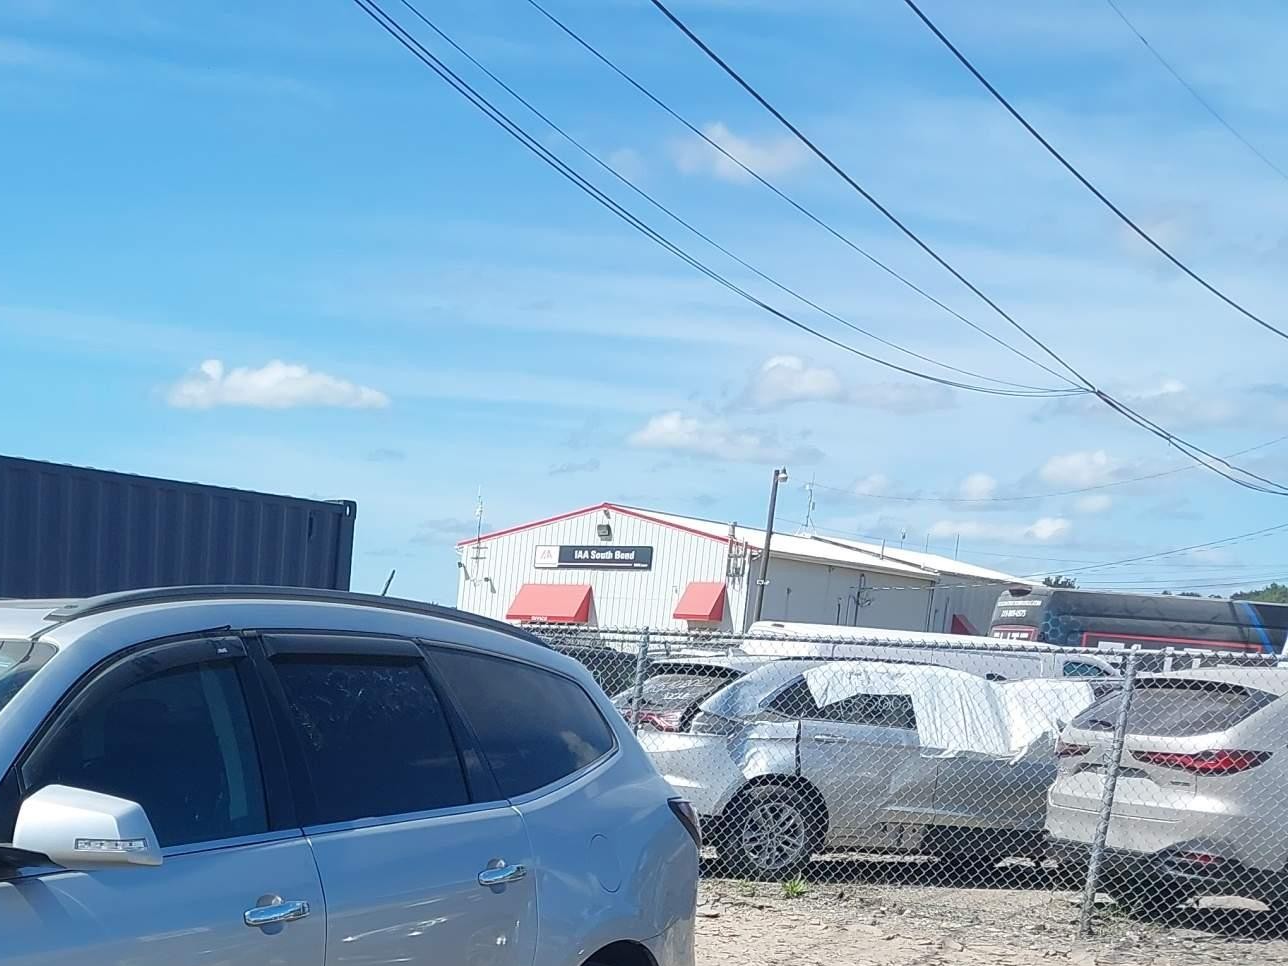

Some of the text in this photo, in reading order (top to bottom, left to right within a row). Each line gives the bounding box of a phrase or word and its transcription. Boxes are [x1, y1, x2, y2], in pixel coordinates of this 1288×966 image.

[574, 550, 635, 560] IAA South Bend
